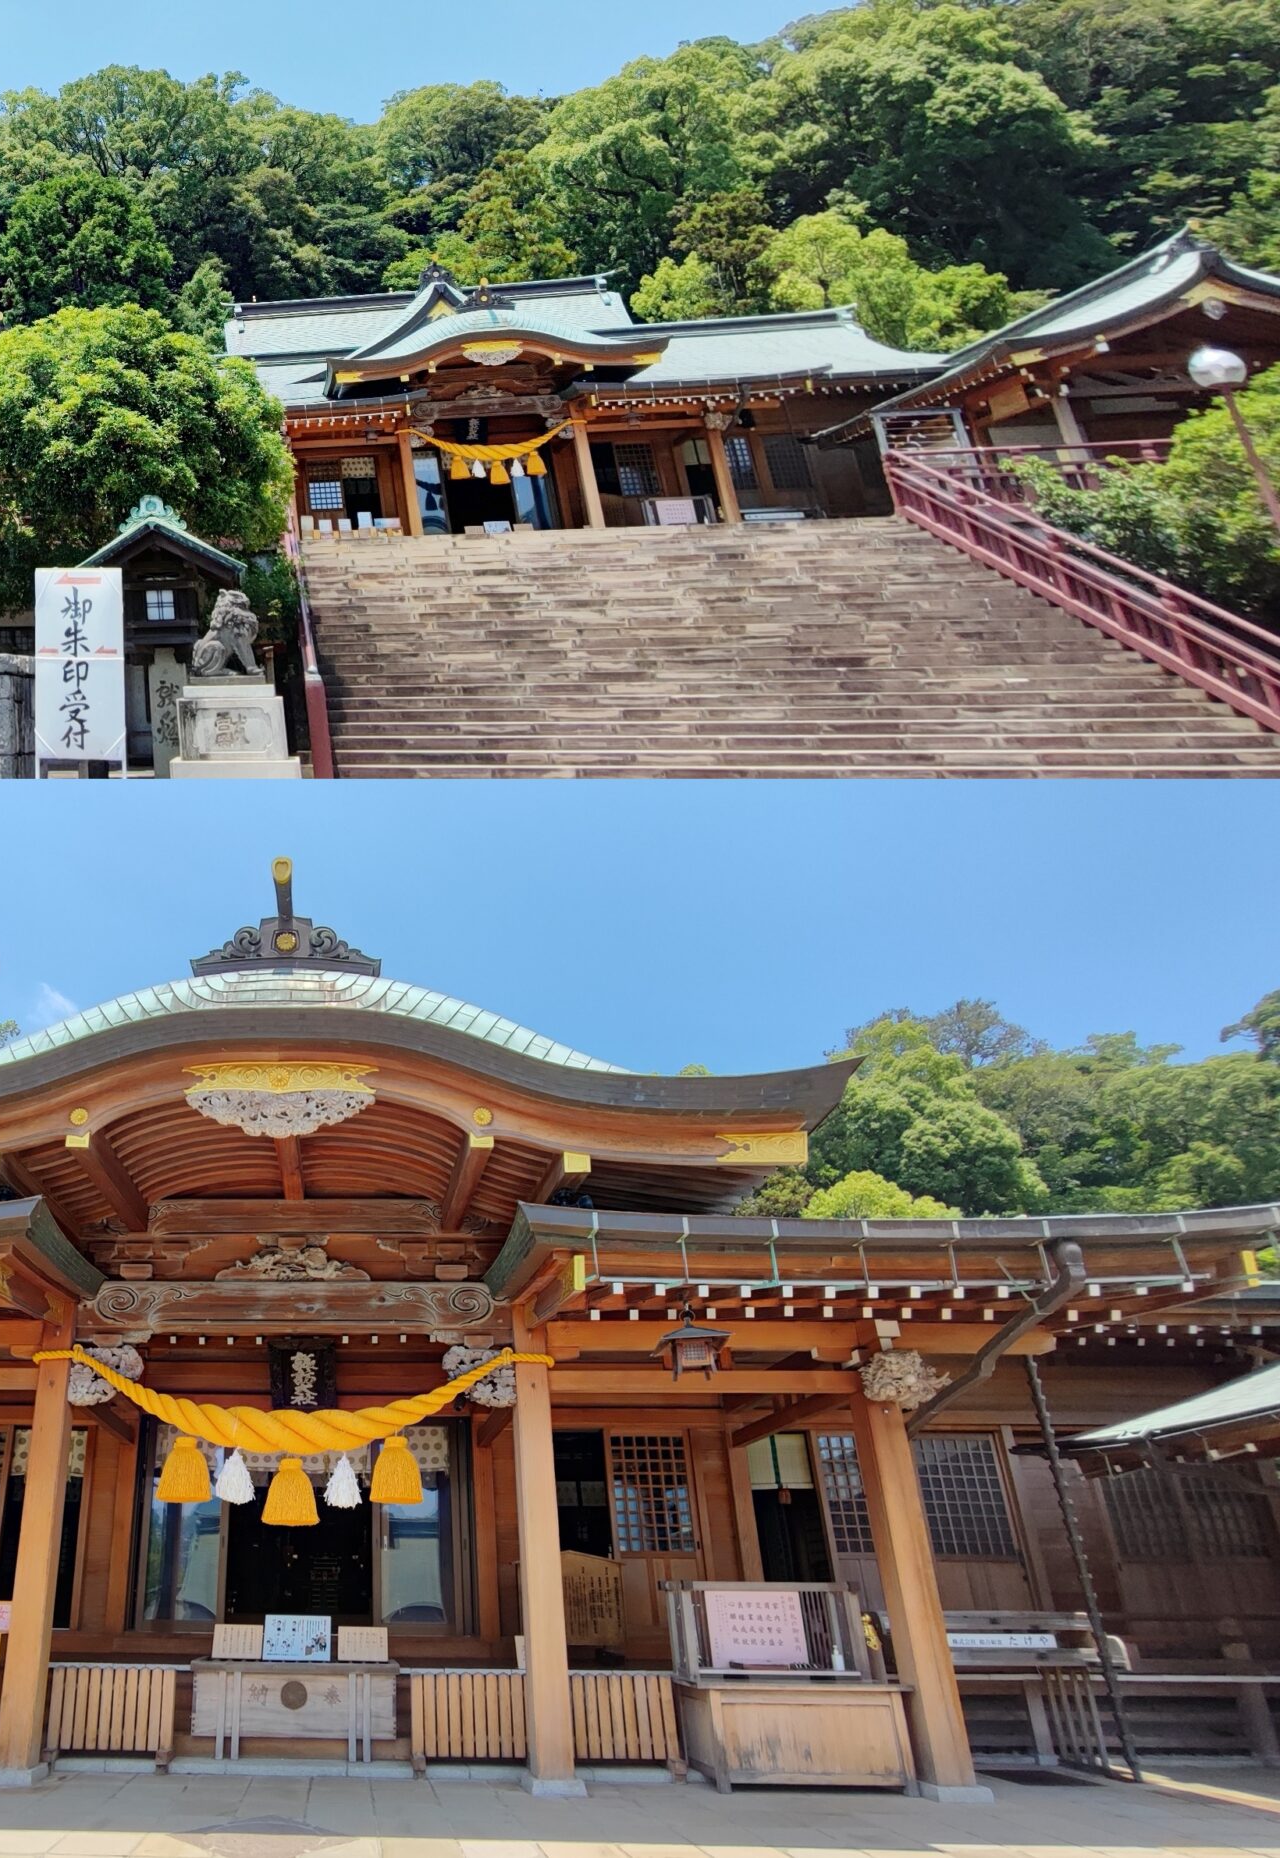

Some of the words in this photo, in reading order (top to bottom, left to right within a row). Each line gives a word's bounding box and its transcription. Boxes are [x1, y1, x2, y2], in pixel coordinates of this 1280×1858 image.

[58, 586, 93, 750] 御朱印受付
[1009, 1635, 1049, 1646] たけや
